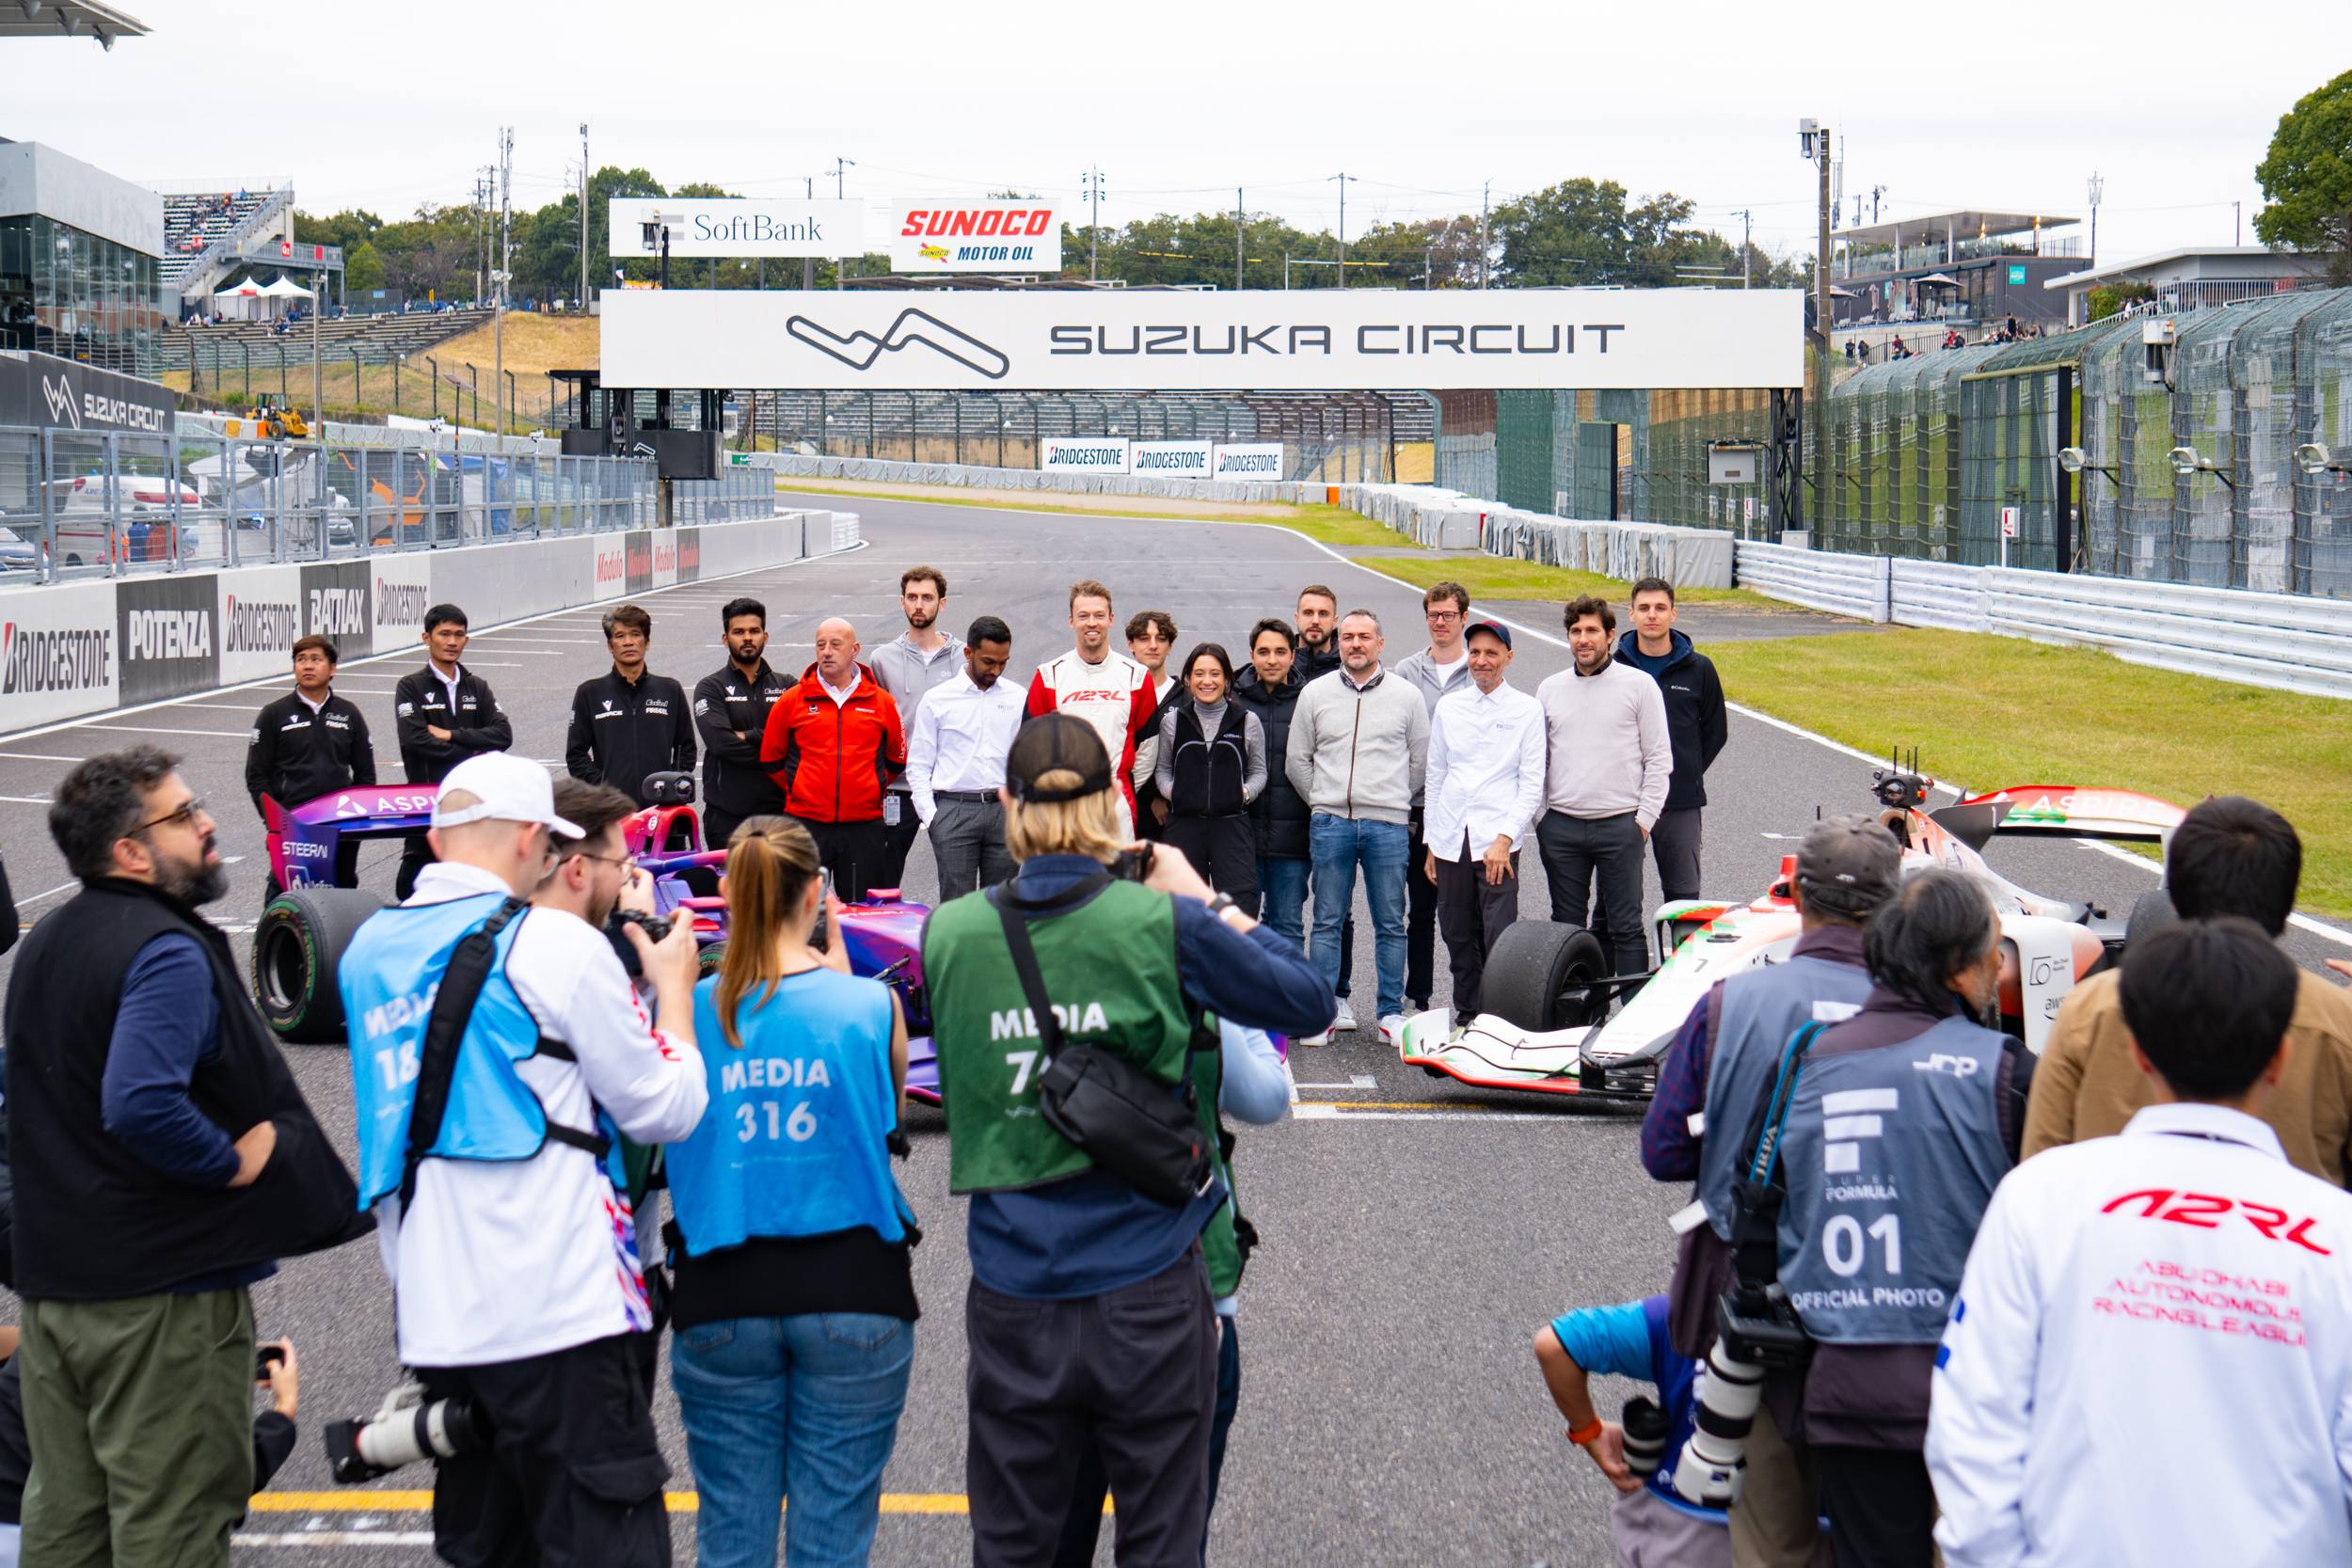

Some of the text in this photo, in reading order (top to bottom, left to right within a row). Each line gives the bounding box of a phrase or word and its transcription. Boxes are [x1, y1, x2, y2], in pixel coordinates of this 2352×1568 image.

[693, 214, 822, 241] SoftBank
[900, 210, 1052, 236] SUNOCO
[958, 246, 1033, 261] MOTOR OIL
[1050, 324, 1626, 356] SUZUKA CIRCUIT
[84, 392, 166, 433] SUZUKA CIRCUIT
[1049, 446, 1123, 466] BRIDGESTONE
[1136, 450, 1206, 469] BRIDGESTONE
[1218, 452, 1279, 472] BRIDGESTONE
[596, 549, 624, 583] Modulo
[627, 546, 651, 578] Modulo
[654, 544, 676, 574] Modulo
[678, 541, 699, 570] Modulo
[376, 577, 427, 626] BRIDGESTONE
[128, 610, 212, 660] POTENZA
[226, 594, 297, 653] BRIDGESTONE
[3, 622, 111, 695] BRIDGESTONE
[1061, 689, 1126, 705] A2RL
[2028, 795, 2166, 821] ASPIRE
[722, 1057, 831, 1094] MEDIA
[1005, 1050, 1052, 1096] 7
[735, 1101, 818, 1143] 316
[1824, 1173, 1897, 1185] SUPER
[1825, 1184, 1899, 1202] FORMULA
[2101, 1189, 2333, 1257] A2RL
[1821, 1212, 1901, 1276] 01
[2136, 1259, 2289, 1298] ABU DHABI
[1791, 1287, 1946, 1311] OFFICIAL PHOTO
[2093, 1295, 2198, 1325] RACING
